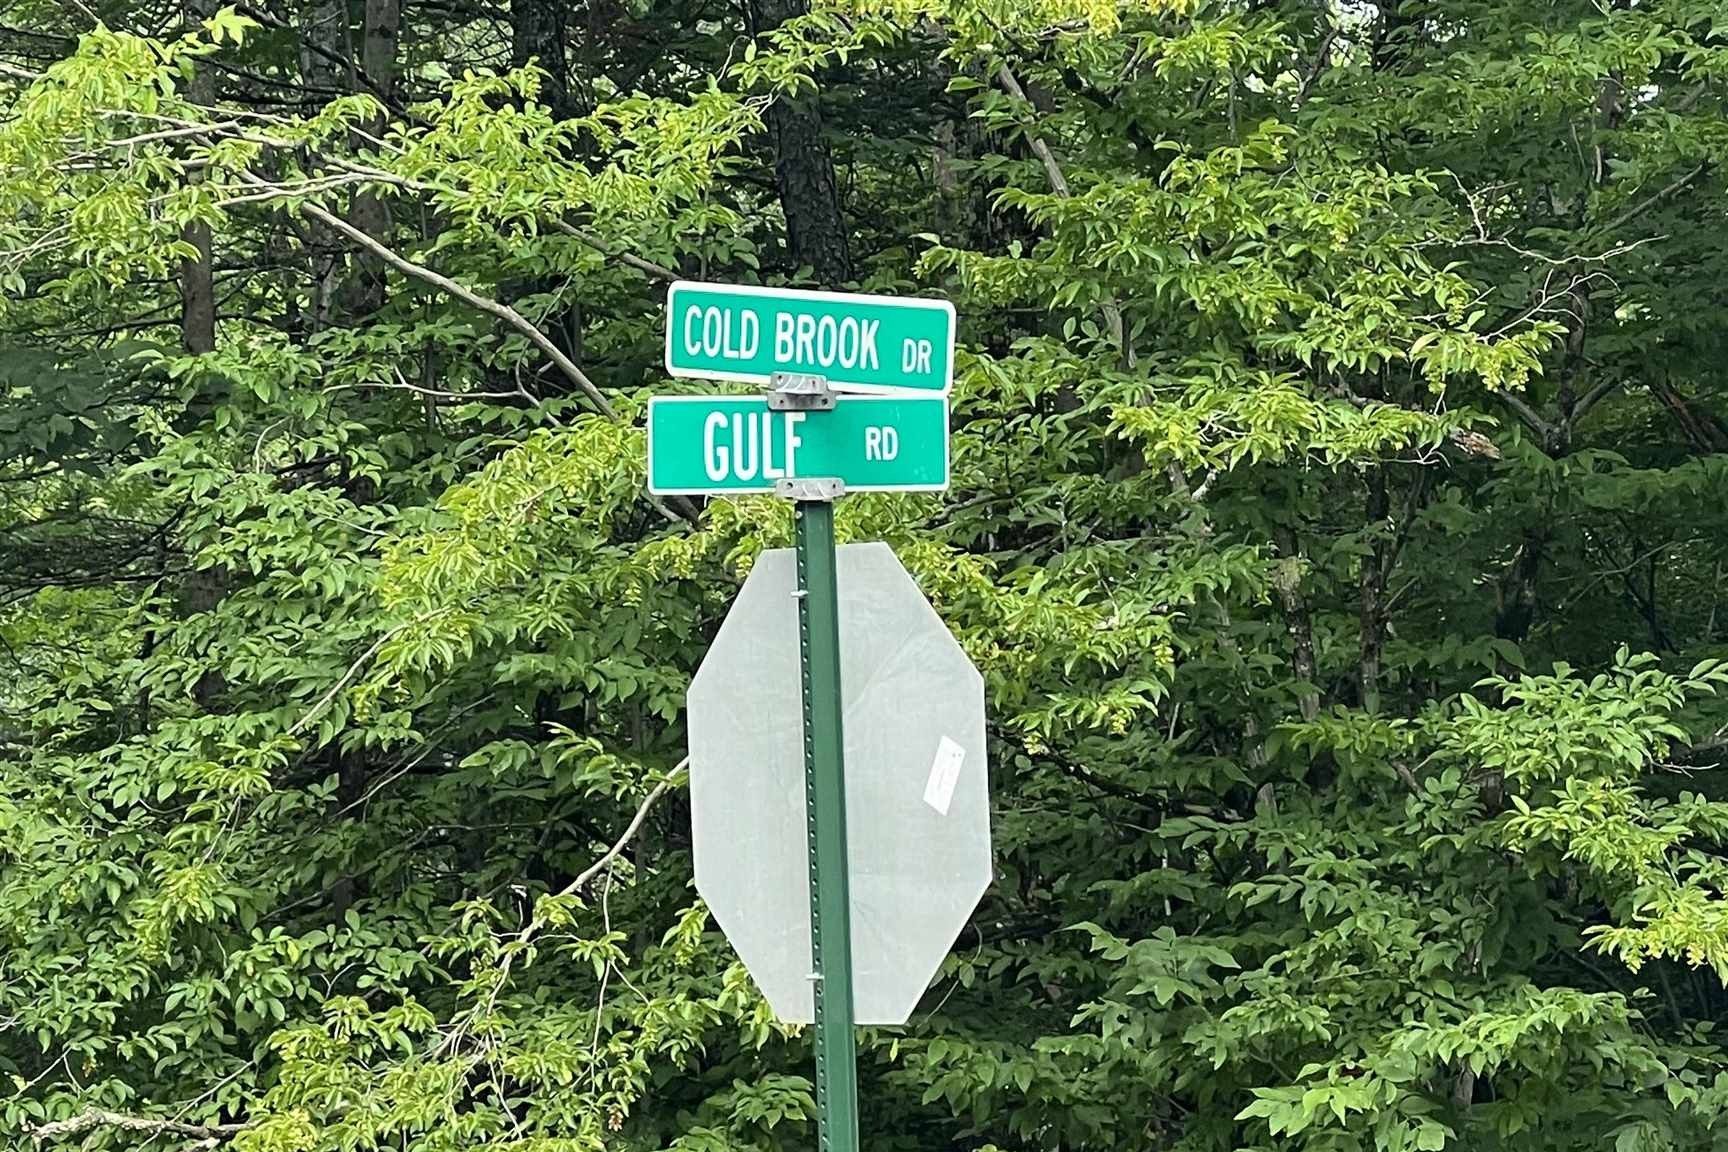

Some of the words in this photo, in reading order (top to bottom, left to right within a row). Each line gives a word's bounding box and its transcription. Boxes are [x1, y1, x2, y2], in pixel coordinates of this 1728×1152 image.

[684, 304, 760, 360] COLD
[774, 312, 880, 371] BROOK
[902, 338, 933, 374] DR
[703, 411, 806, 482] GULF
[864, 426, 898, 461] RD
